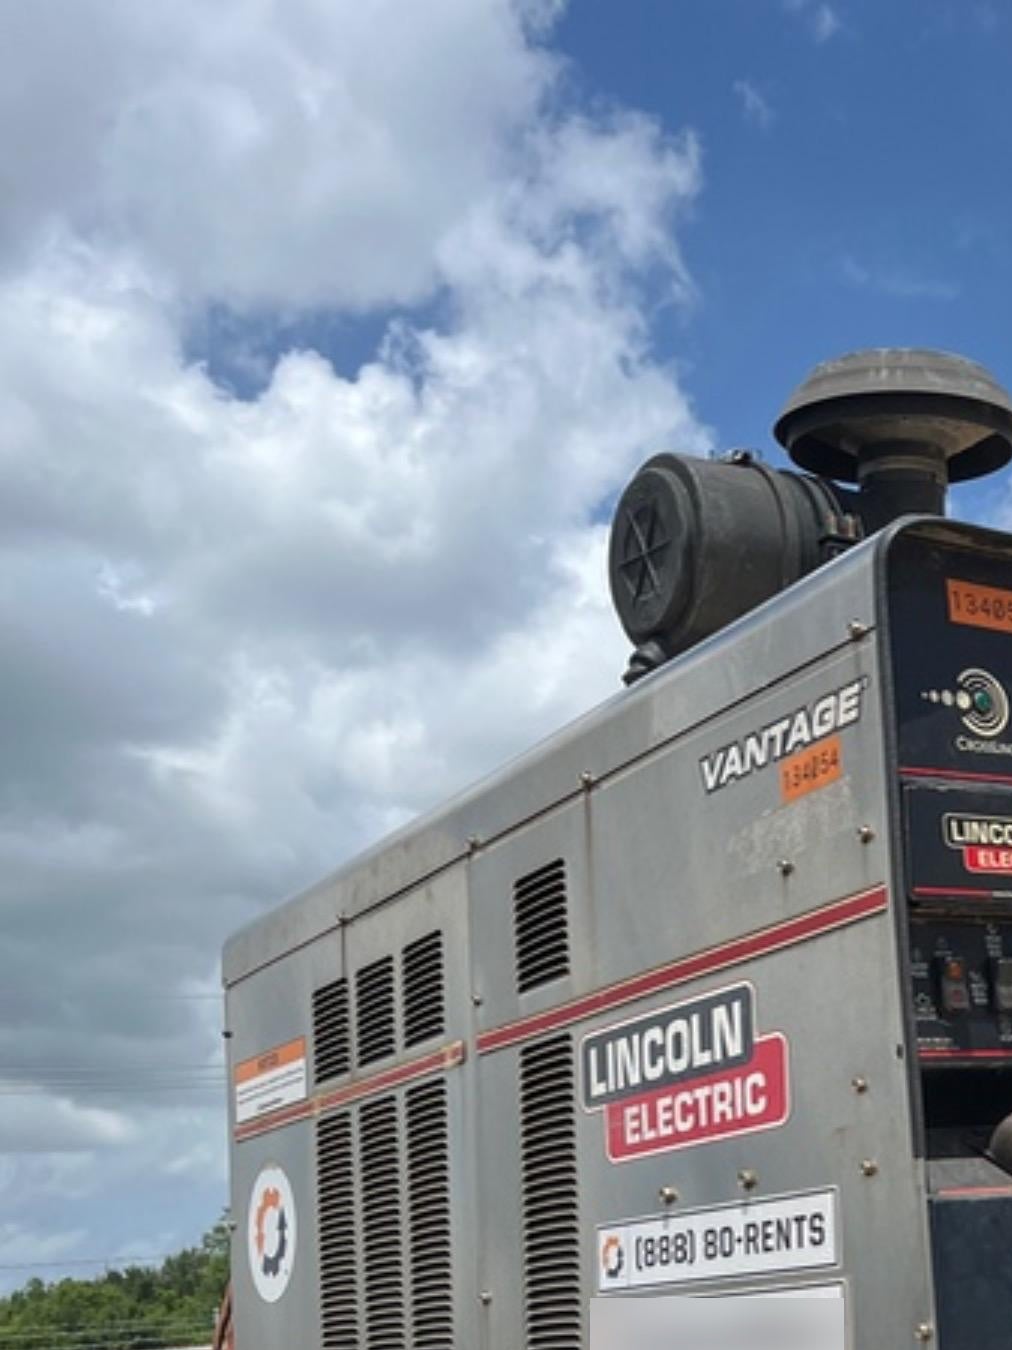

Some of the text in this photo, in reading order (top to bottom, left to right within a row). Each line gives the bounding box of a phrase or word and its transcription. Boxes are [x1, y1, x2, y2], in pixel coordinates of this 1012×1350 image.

[700, 681, 863, 794] VANTAGE
[589, 1000, 742, 1098] LINCOLN
[623, 1072, 767, 1146] ELECTRIC
[634, 1212, 826, 1273] (888) 80-RENTS
